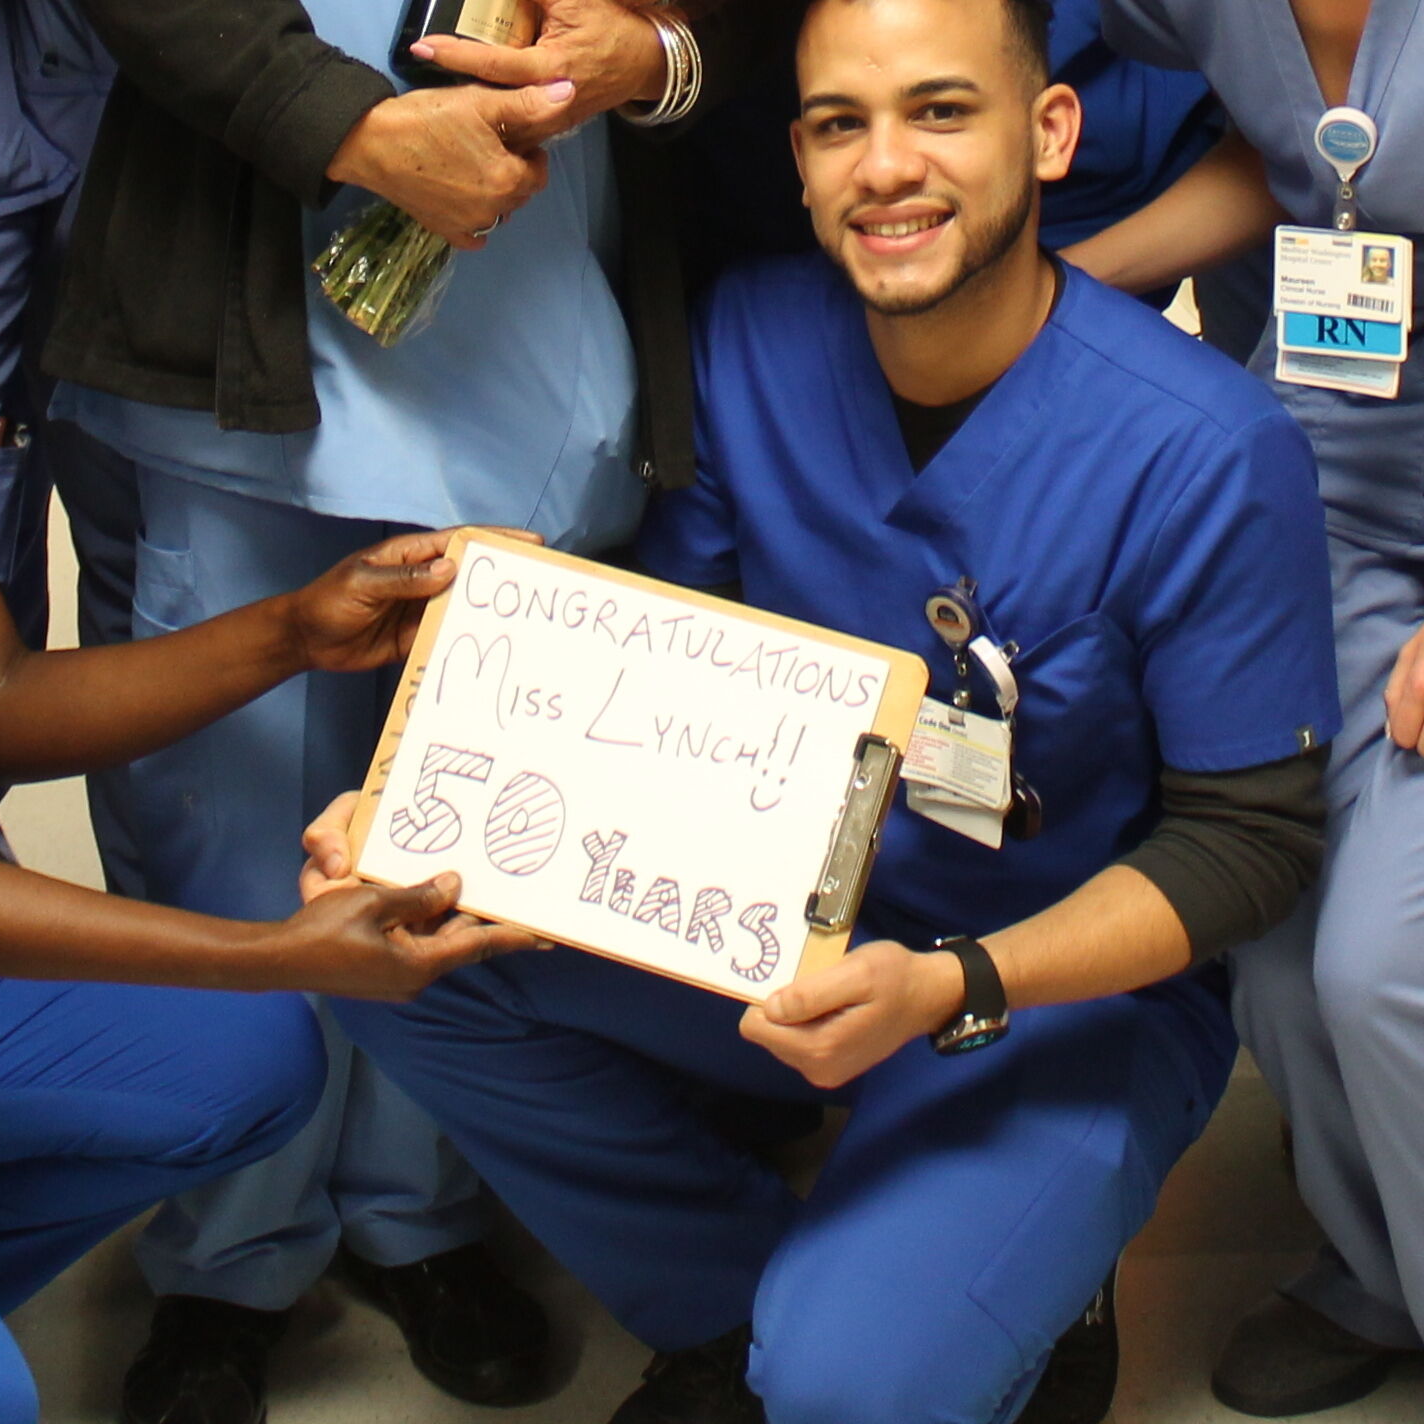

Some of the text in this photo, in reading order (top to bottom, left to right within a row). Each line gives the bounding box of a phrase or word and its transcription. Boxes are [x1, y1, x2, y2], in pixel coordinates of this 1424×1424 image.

[1317, 318, 1366, 346] RN
[466, 556, 877, 708] CONGRATULATIONS
[389, 743, 566, 876] 50
